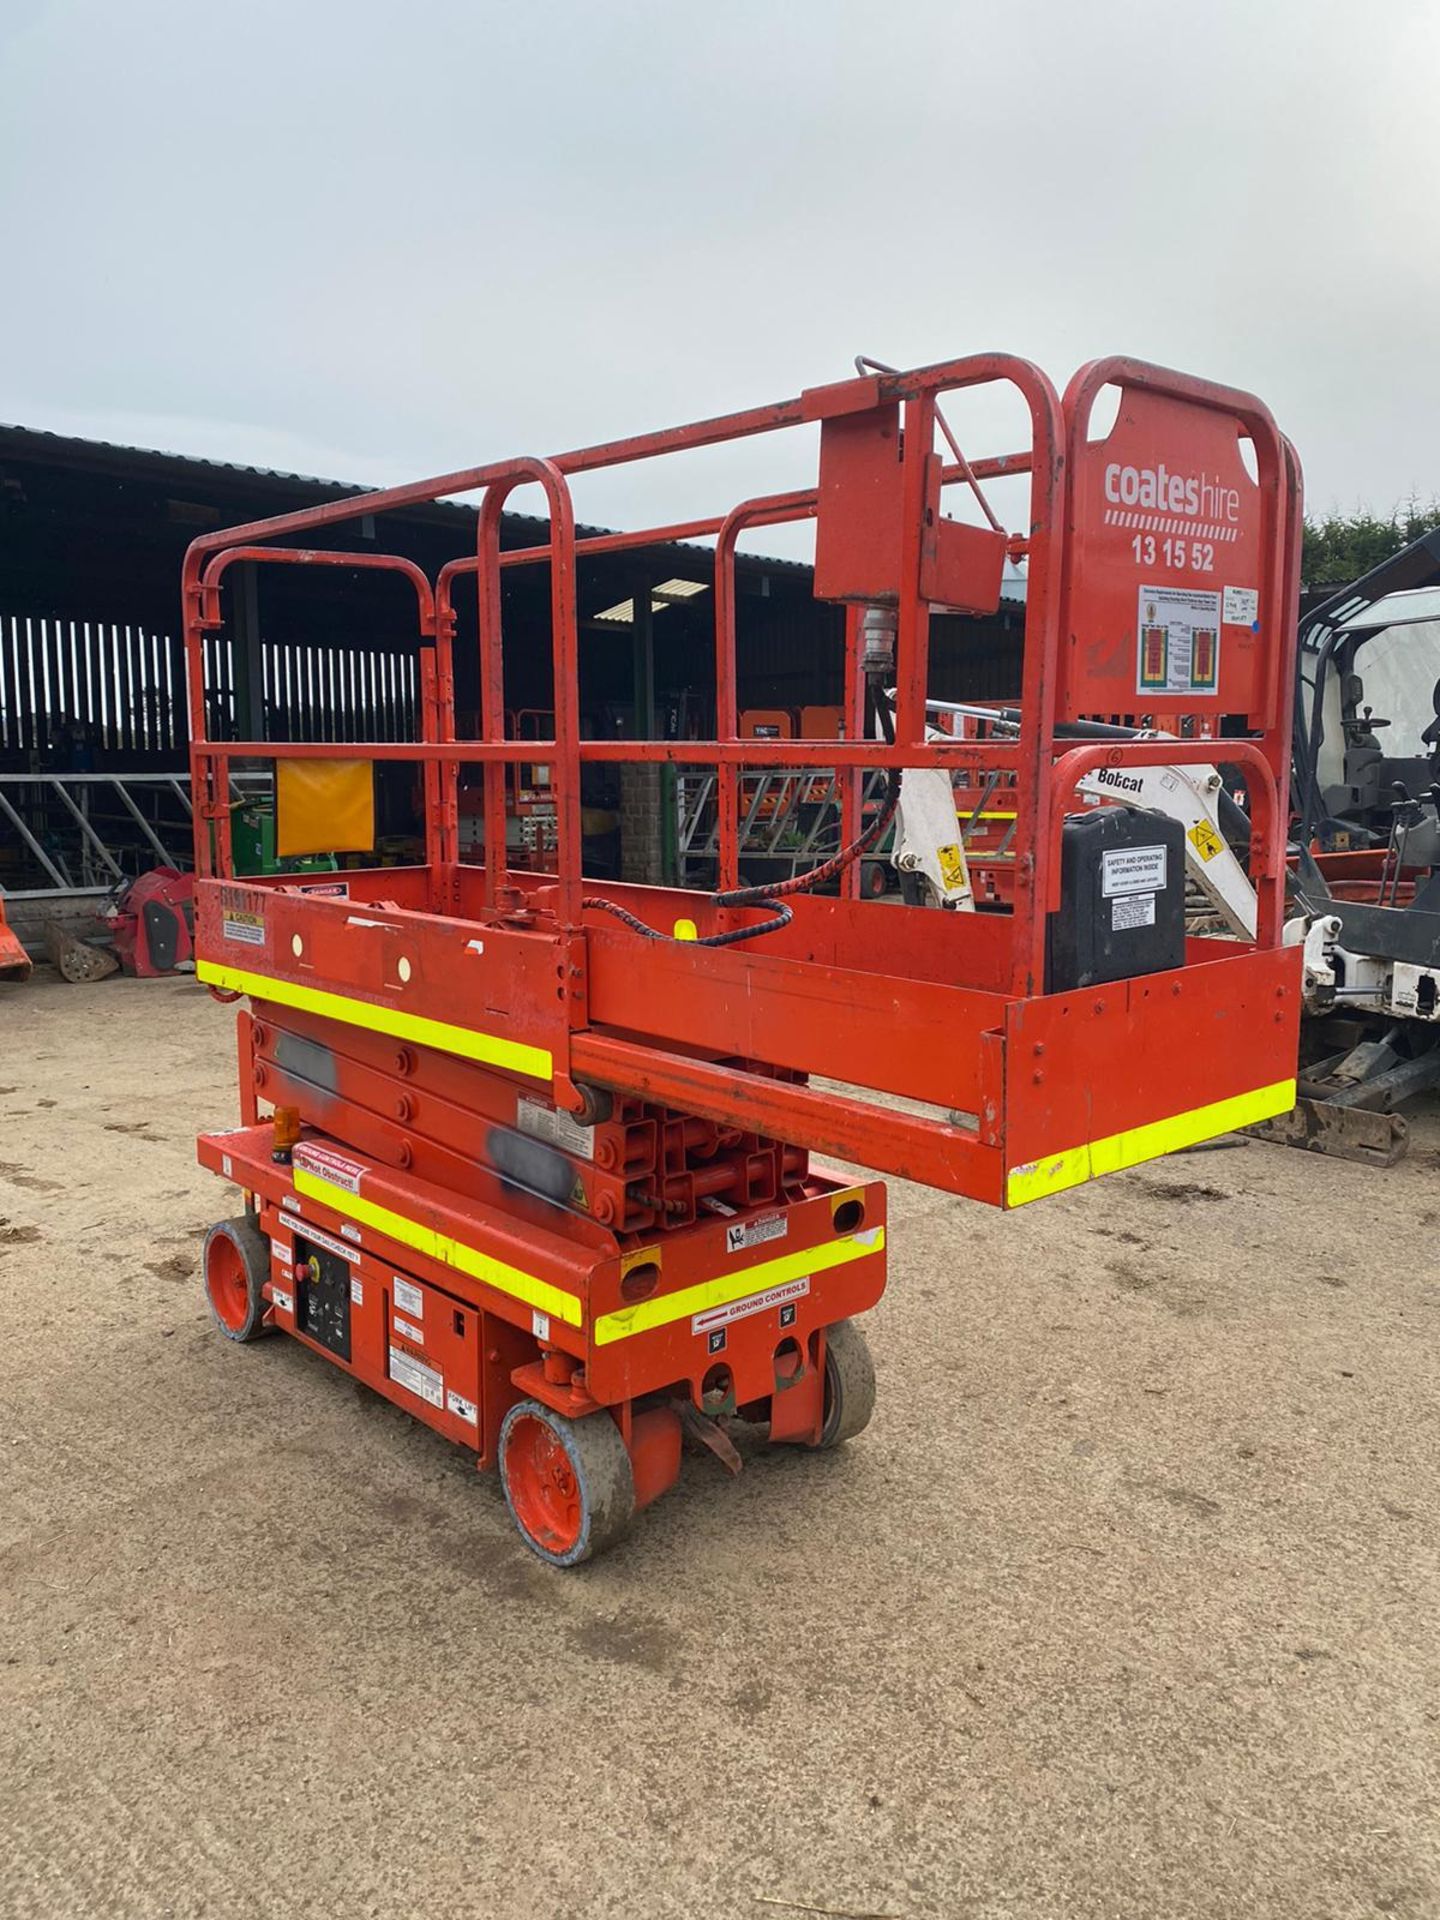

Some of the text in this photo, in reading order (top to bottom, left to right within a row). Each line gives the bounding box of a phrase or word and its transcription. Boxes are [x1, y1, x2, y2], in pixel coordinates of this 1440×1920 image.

[1131, 534, 1214, 572] 13 15 52
[1097, 768, 1144, 793] Bobcat
[1107, 853, 1163, 867] SAFETY AND OPERATING
[1111, 865, 1143, 876] INFORMATION
[235, 913, 257, 924] CAUTION
[729, 1296, 764, 1317] GROUND
[765, 1281, 806, 1303] CONTROLS
